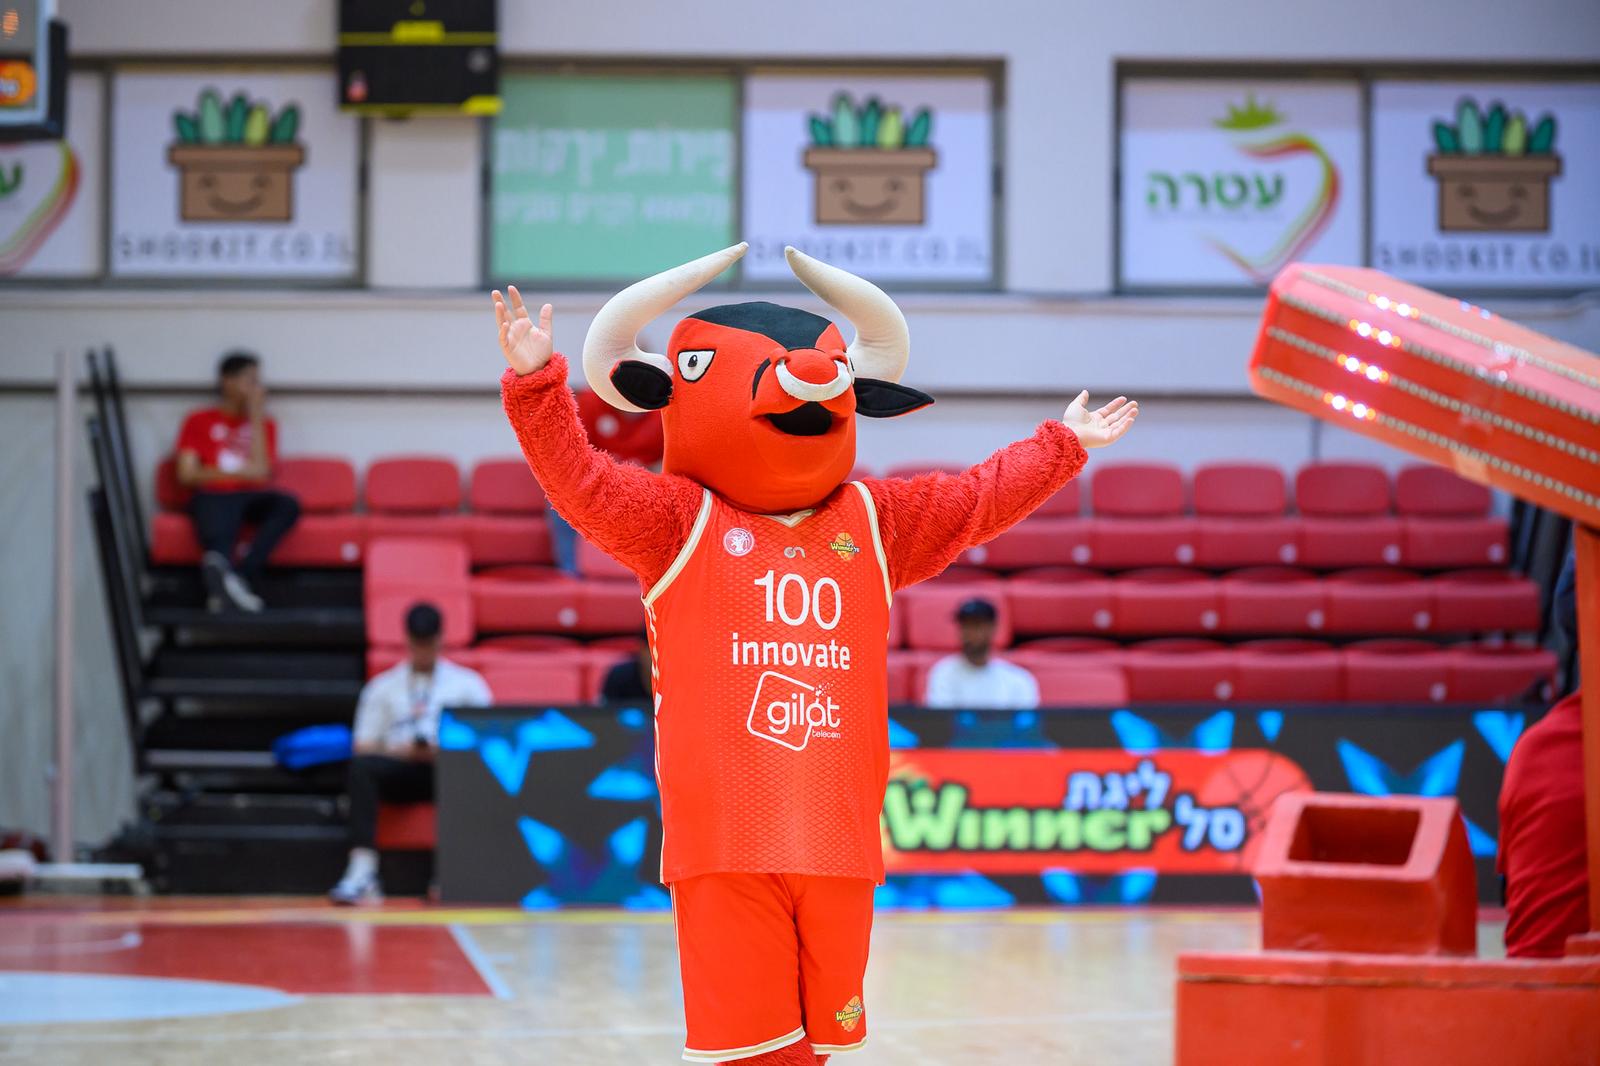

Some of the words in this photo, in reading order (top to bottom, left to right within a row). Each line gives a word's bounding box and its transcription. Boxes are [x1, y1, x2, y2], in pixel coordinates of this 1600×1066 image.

[1147, 171, 1285, 210] עטרה
[753, 569, 842, 630] 100
[732, 632, 851, 670] innovate
[766, 692, 841, 735] gilat
[812, 729, 841, 740] telecom
[1064, 760, 1172, 811] ליגת
[884, 781, 1172, 851] Winner
[1174, 793, 1247, 851] סל
